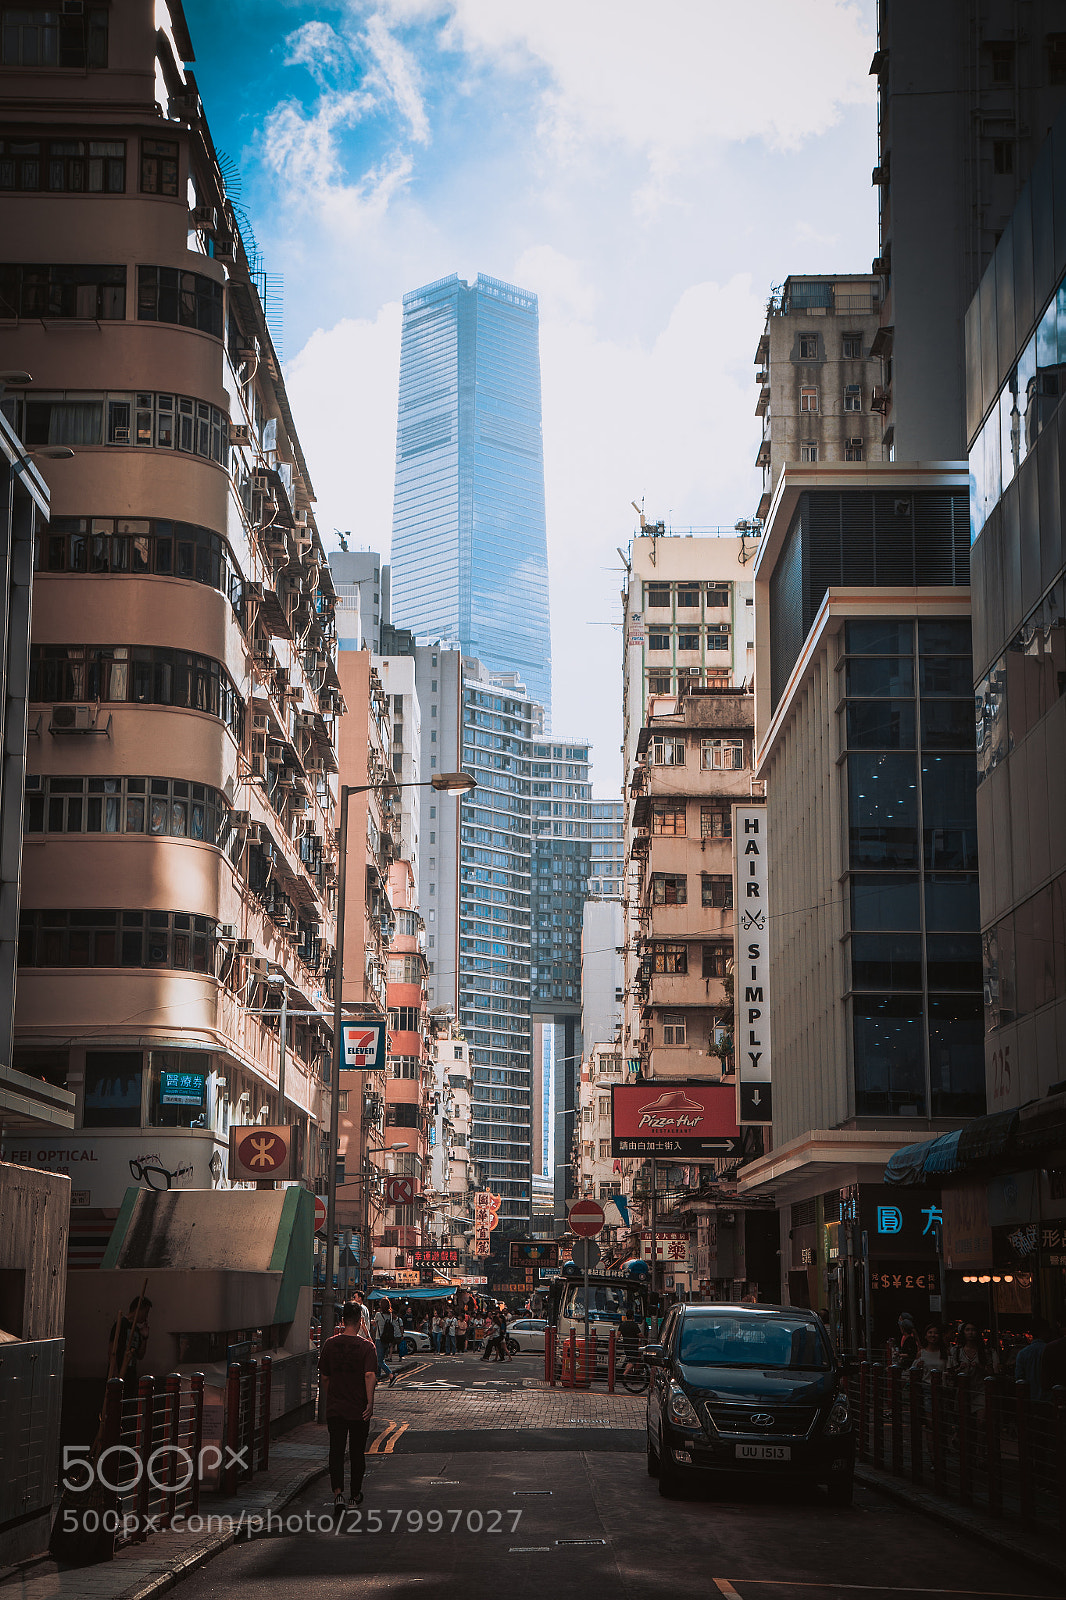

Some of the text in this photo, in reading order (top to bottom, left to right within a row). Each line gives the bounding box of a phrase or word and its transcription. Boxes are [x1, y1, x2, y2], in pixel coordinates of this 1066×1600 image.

[744, 818, 760, 897] HAIR
[745, 943, 764, 1067] SIMPLY
[638, 1114, 704, 1129] Pizza Hut
[619, 1140, 682, 1151] 請由白加士街入
[11, 1150, 32, 1162] FEI
[37, 1149, 98, 1162] OPTICAL
[667, 1241, 686, 1260] 藥
[742, 1446, 784, 1458] UU 1513
